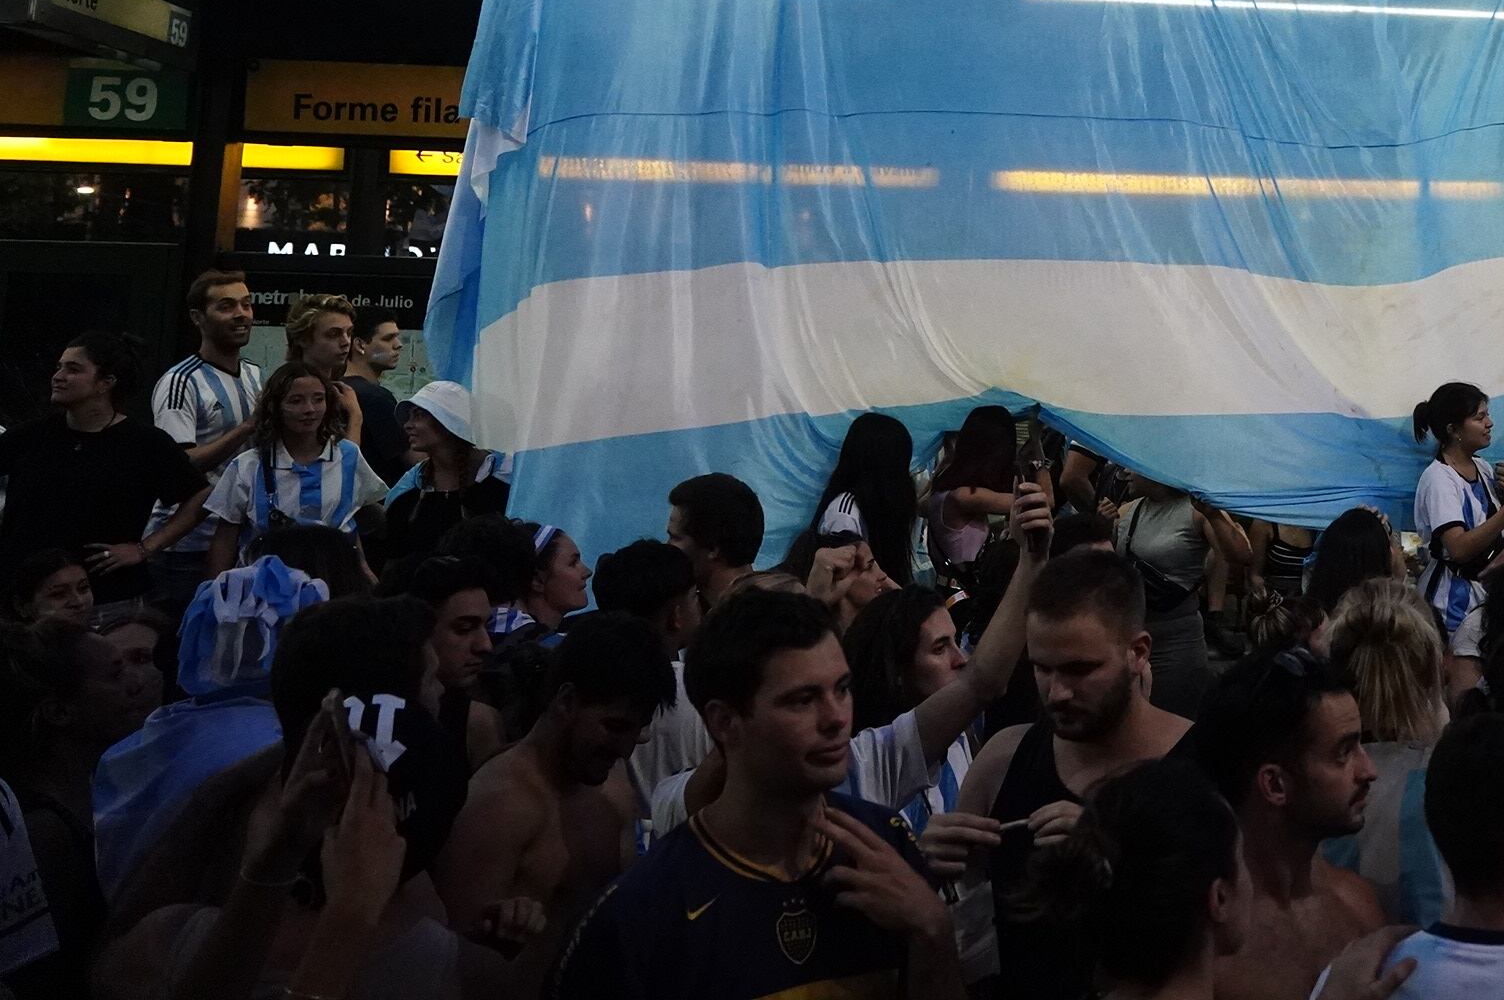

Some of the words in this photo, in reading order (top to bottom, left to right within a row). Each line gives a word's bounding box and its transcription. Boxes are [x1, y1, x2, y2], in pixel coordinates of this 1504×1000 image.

[170, 18, 188, 48] 59
[88, 75, 158, 122] 59
[294, 93, 398, 122] Forme
[411, 96, 460, 124] fila
[351, 294, 371, 308] de
[374, 295, 414, 309] Julio
